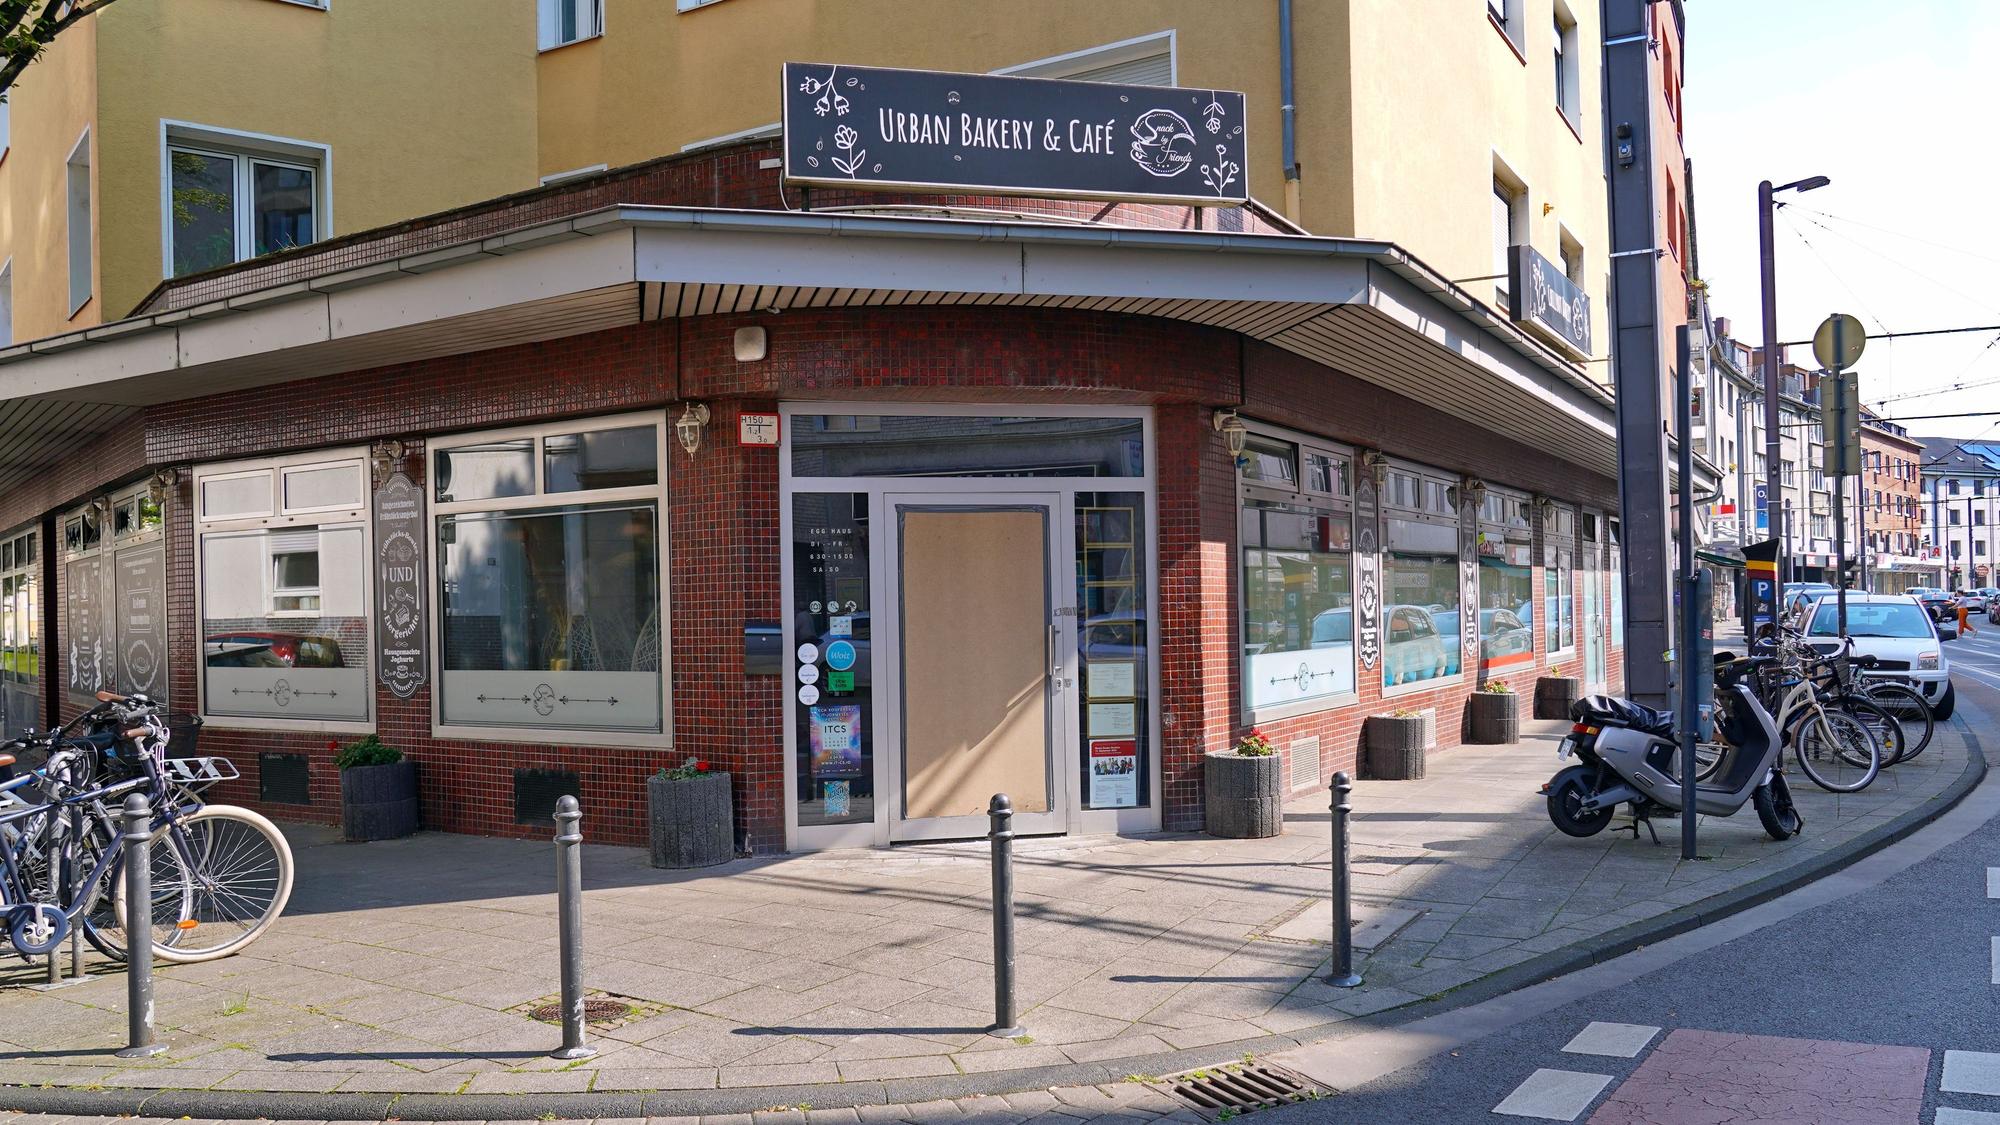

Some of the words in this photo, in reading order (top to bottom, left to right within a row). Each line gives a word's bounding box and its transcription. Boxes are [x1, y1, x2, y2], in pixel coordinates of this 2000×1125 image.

[879, 107, 950, 145] URBAN
[961, 113, 1034, 150] BAKERY
[1043, 118, 1061, 152] &
[1069, 119, 1115, 155] CAFÉ
[1145, 114, 1175, 142] Snack
[1156, 134, 1193, 163] Friends
[1160, 135, 1169, 145] by
[388, 566, 413, 583] UND
[1757, 581, 1769, 597] P
[824, 725, 847, 733] ITCS
